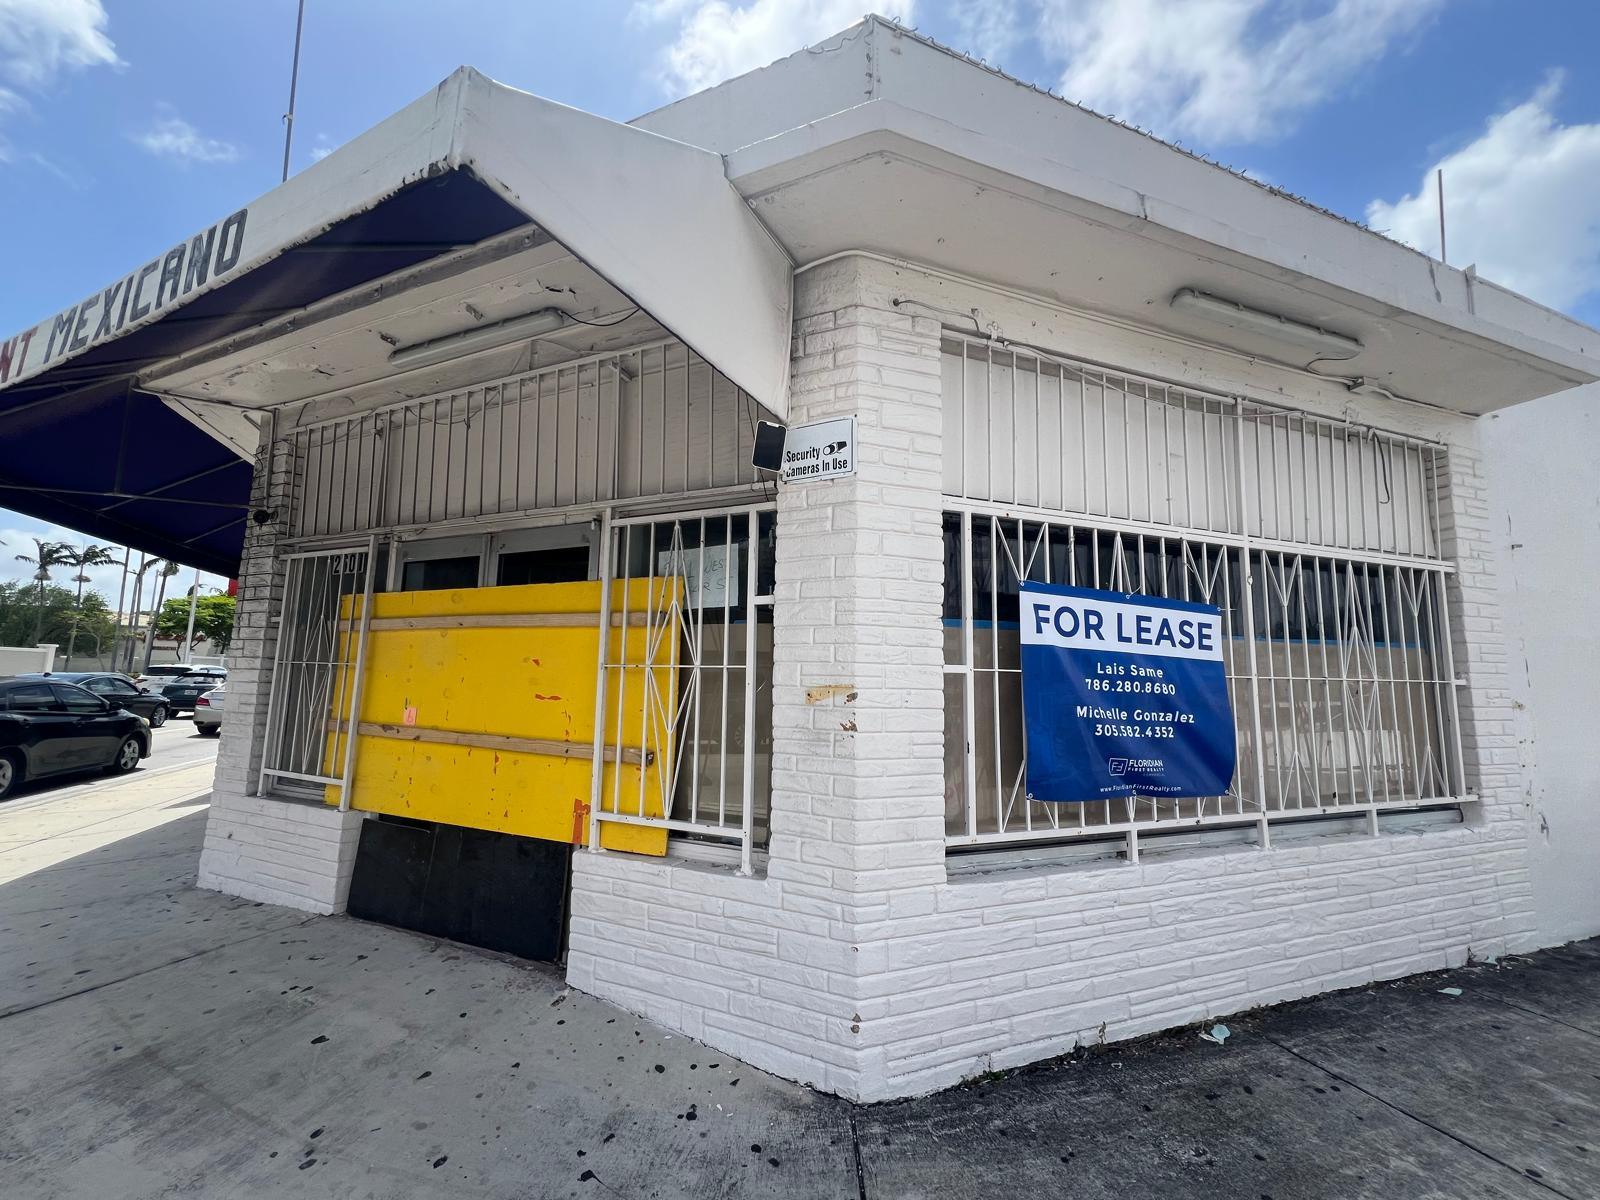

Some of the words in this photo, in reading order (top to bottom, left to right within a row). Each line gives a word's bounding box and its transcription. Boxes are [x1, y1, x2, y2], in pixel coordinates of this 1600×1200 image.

[44, 208, 248, 364] MEXICANO
[786, 446, 820, 462] Security
[786, 463, 819, 478] Cameras
[822, 460, 830, 471] In
[832, 458, 848, 470] Use
[1032, 603, 1105, 640] FOR
[1117, 612, 1213, 651] LEASE
[1097, 662, 1125, 675] Lais
[1130, 664, 1163, 678] Same
[1085, 679, 1176, 695] 786.280.8680
[1076, 706, 1128, 720] Michelle
[1133, 709, 1195, 723] Gonzalez
[1094, 724, 1174, 738] 305.582.4352
[1128, 759, 1164, 767] FLORIDIAN
